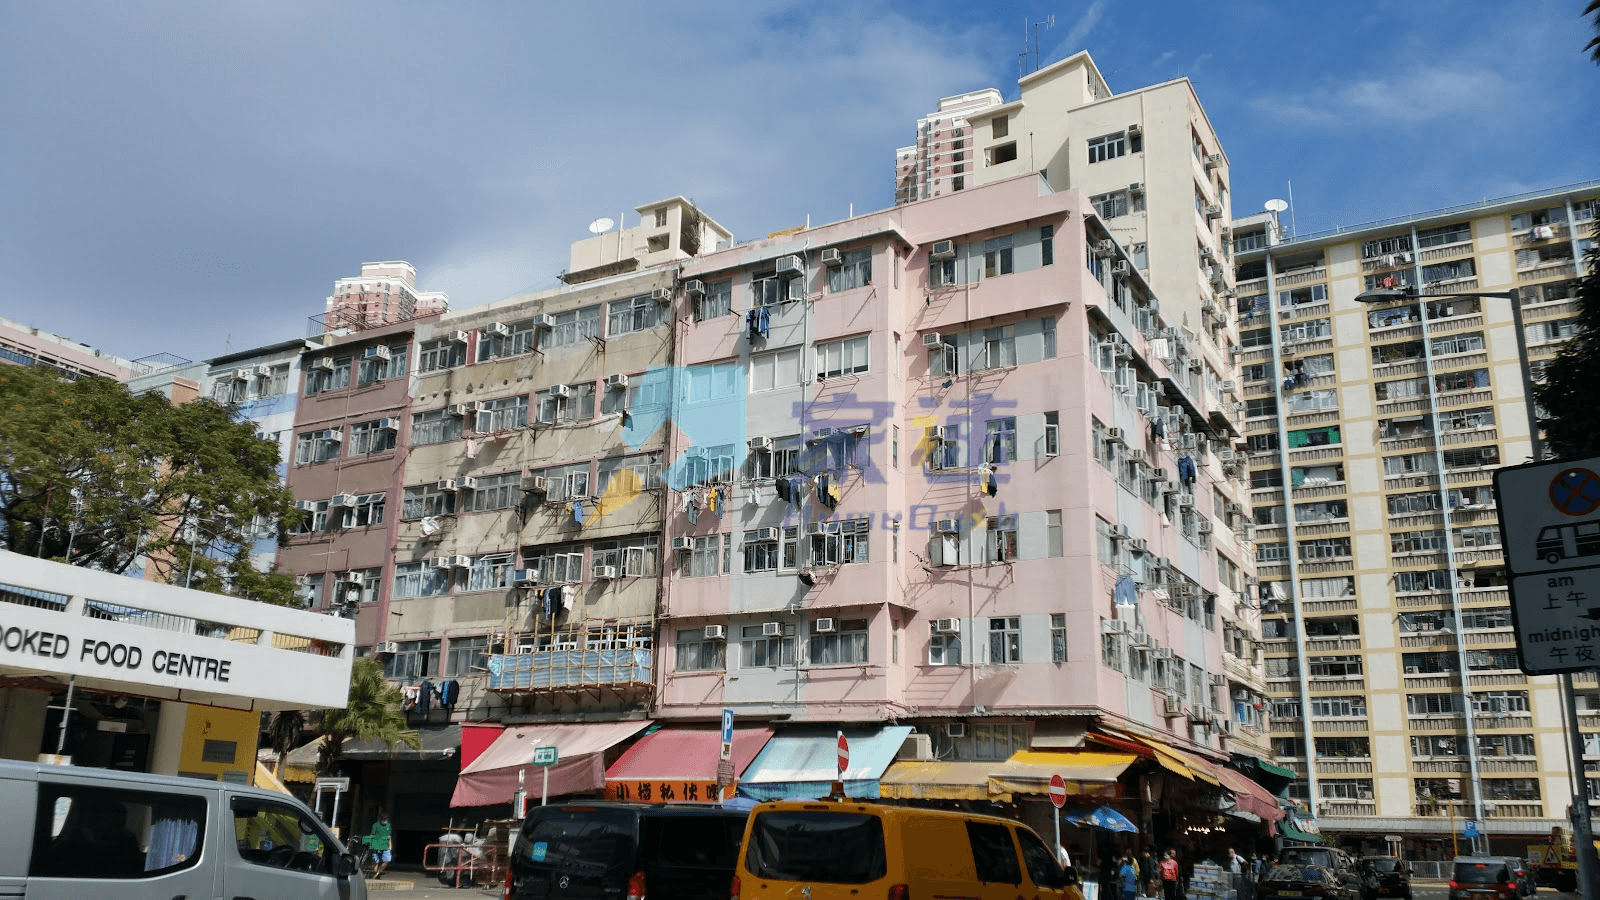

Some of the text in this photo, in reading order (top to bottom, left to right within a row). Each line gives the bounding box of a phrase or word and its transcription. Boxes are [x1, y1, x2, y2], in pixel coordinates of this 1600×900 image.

[1547, 576, 1574, 588] am
[1542, 590, 1587, 610] 上午
[0, 625, 232, 682] OKED FOOD CENTRE
[1549, 644, 1595, 663] 午夜
[723, 712, 732, 740] P
